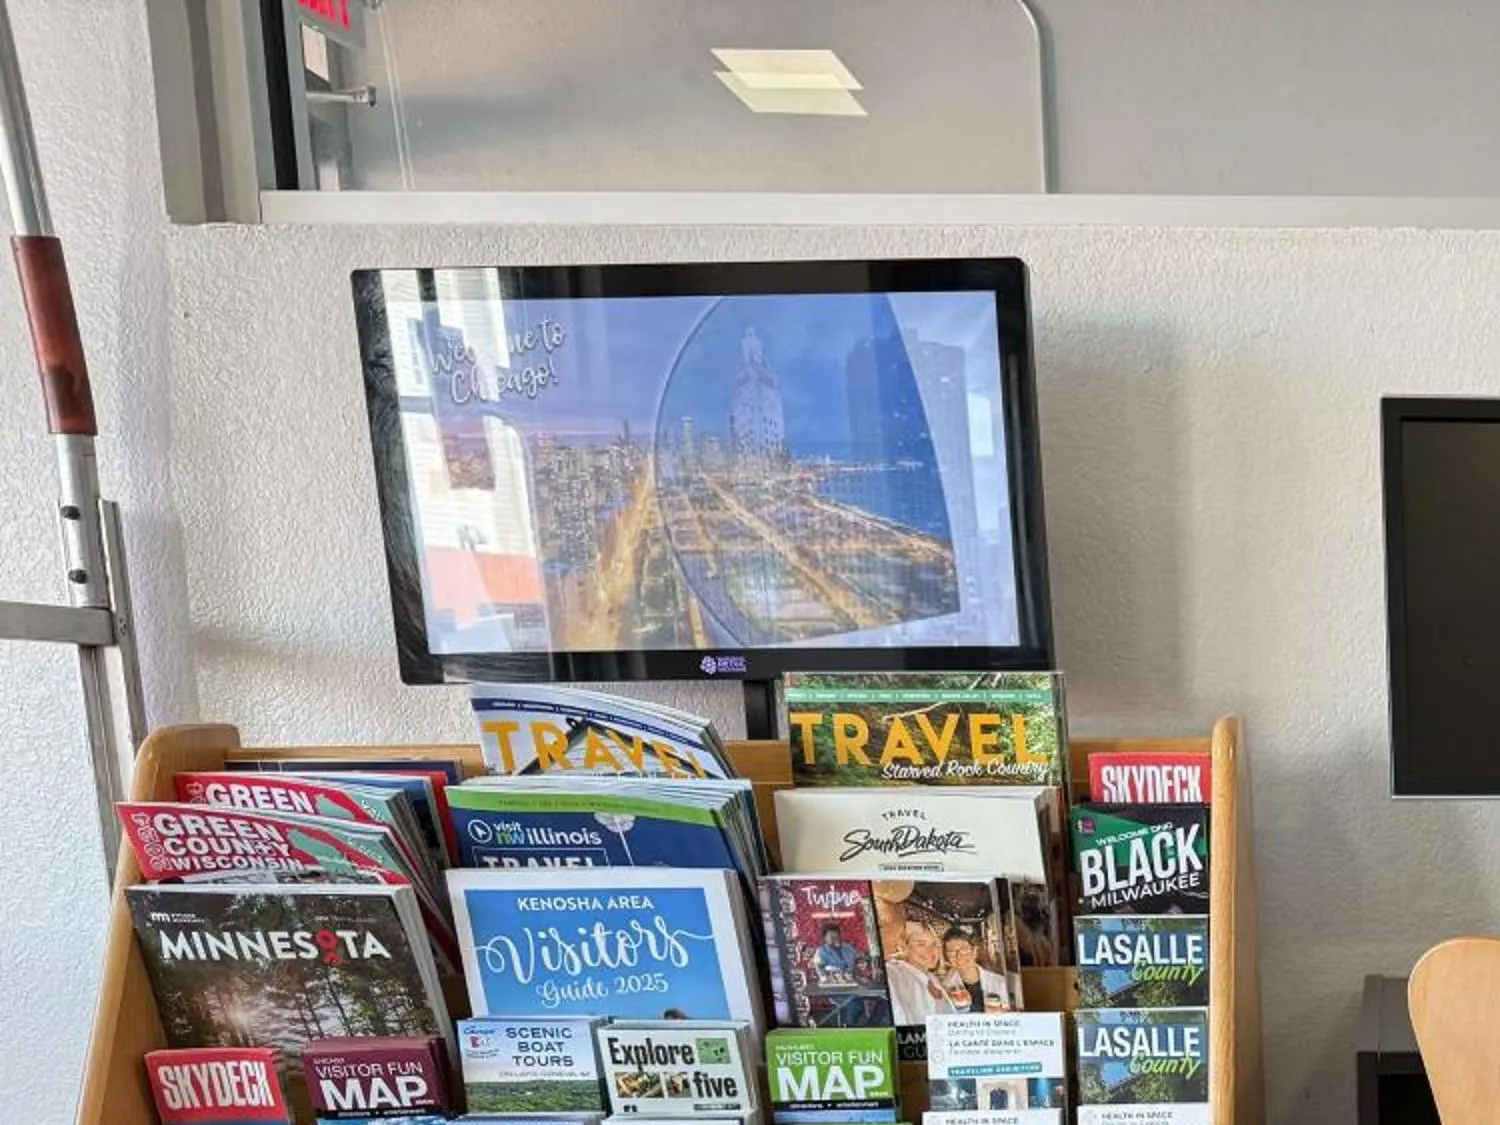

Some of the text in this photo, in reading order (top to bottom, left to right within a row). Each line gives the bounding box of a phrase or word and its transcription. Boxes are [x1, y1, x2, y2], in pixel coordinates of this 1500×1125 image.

[789, 712, 1050, 766] TRAVEL
[881, 759, 1050, 782] Starved Rock Country
[1101, 765, 1203, 803] SKYDECK
[205, 783, 314, 814] GREEN
[153, 813, 286, 842] GREEN
[494, 821, 521, 833] visit
[881, 809, 926, 820] TRAVEL
[163, 836, 291, 858] COUNTY
[528, 828, 602, 845] illinois
[840, 826, 975, 862] South Dakota
[169, 856, 308, 871] WISCONSIN
[1080, 823, 1202, 896] BLACK
[517, 896, 654, 911] KENOSHA AREA
[1092, 872, 1200, 908] MILWAUKEE
[159, 929, 392, 961] MINNESOTA
[468, 915, 714, 984] Visitors
[1078, 934, 1202, 965] LASALLE
[1129, 958, 1202, 985] County
[537, 973, 669, 1008] Guide 2025
[506, 1027, 573, 1039] SCENIC
[518, 1041, 564, 1053] BOAT
[1077, 1027, 1200, 1057] LASALLE
[512, 1055, 574, 1067] TOURS
[608, 1038, 695, 1071] Explore
[776, 1050, 883, 1065] VISITOR FUN
[1129, 1053, 1199, 1080] County
[158, 1060, 275, 1109] SKYDECK
[315, 1061, 422, 1079] VISITOR FUN
[693, 1072, 737, 1096] five
[777, 1065, 885, 1100] MAP
[318, 1076, 427, 1110] MAP
